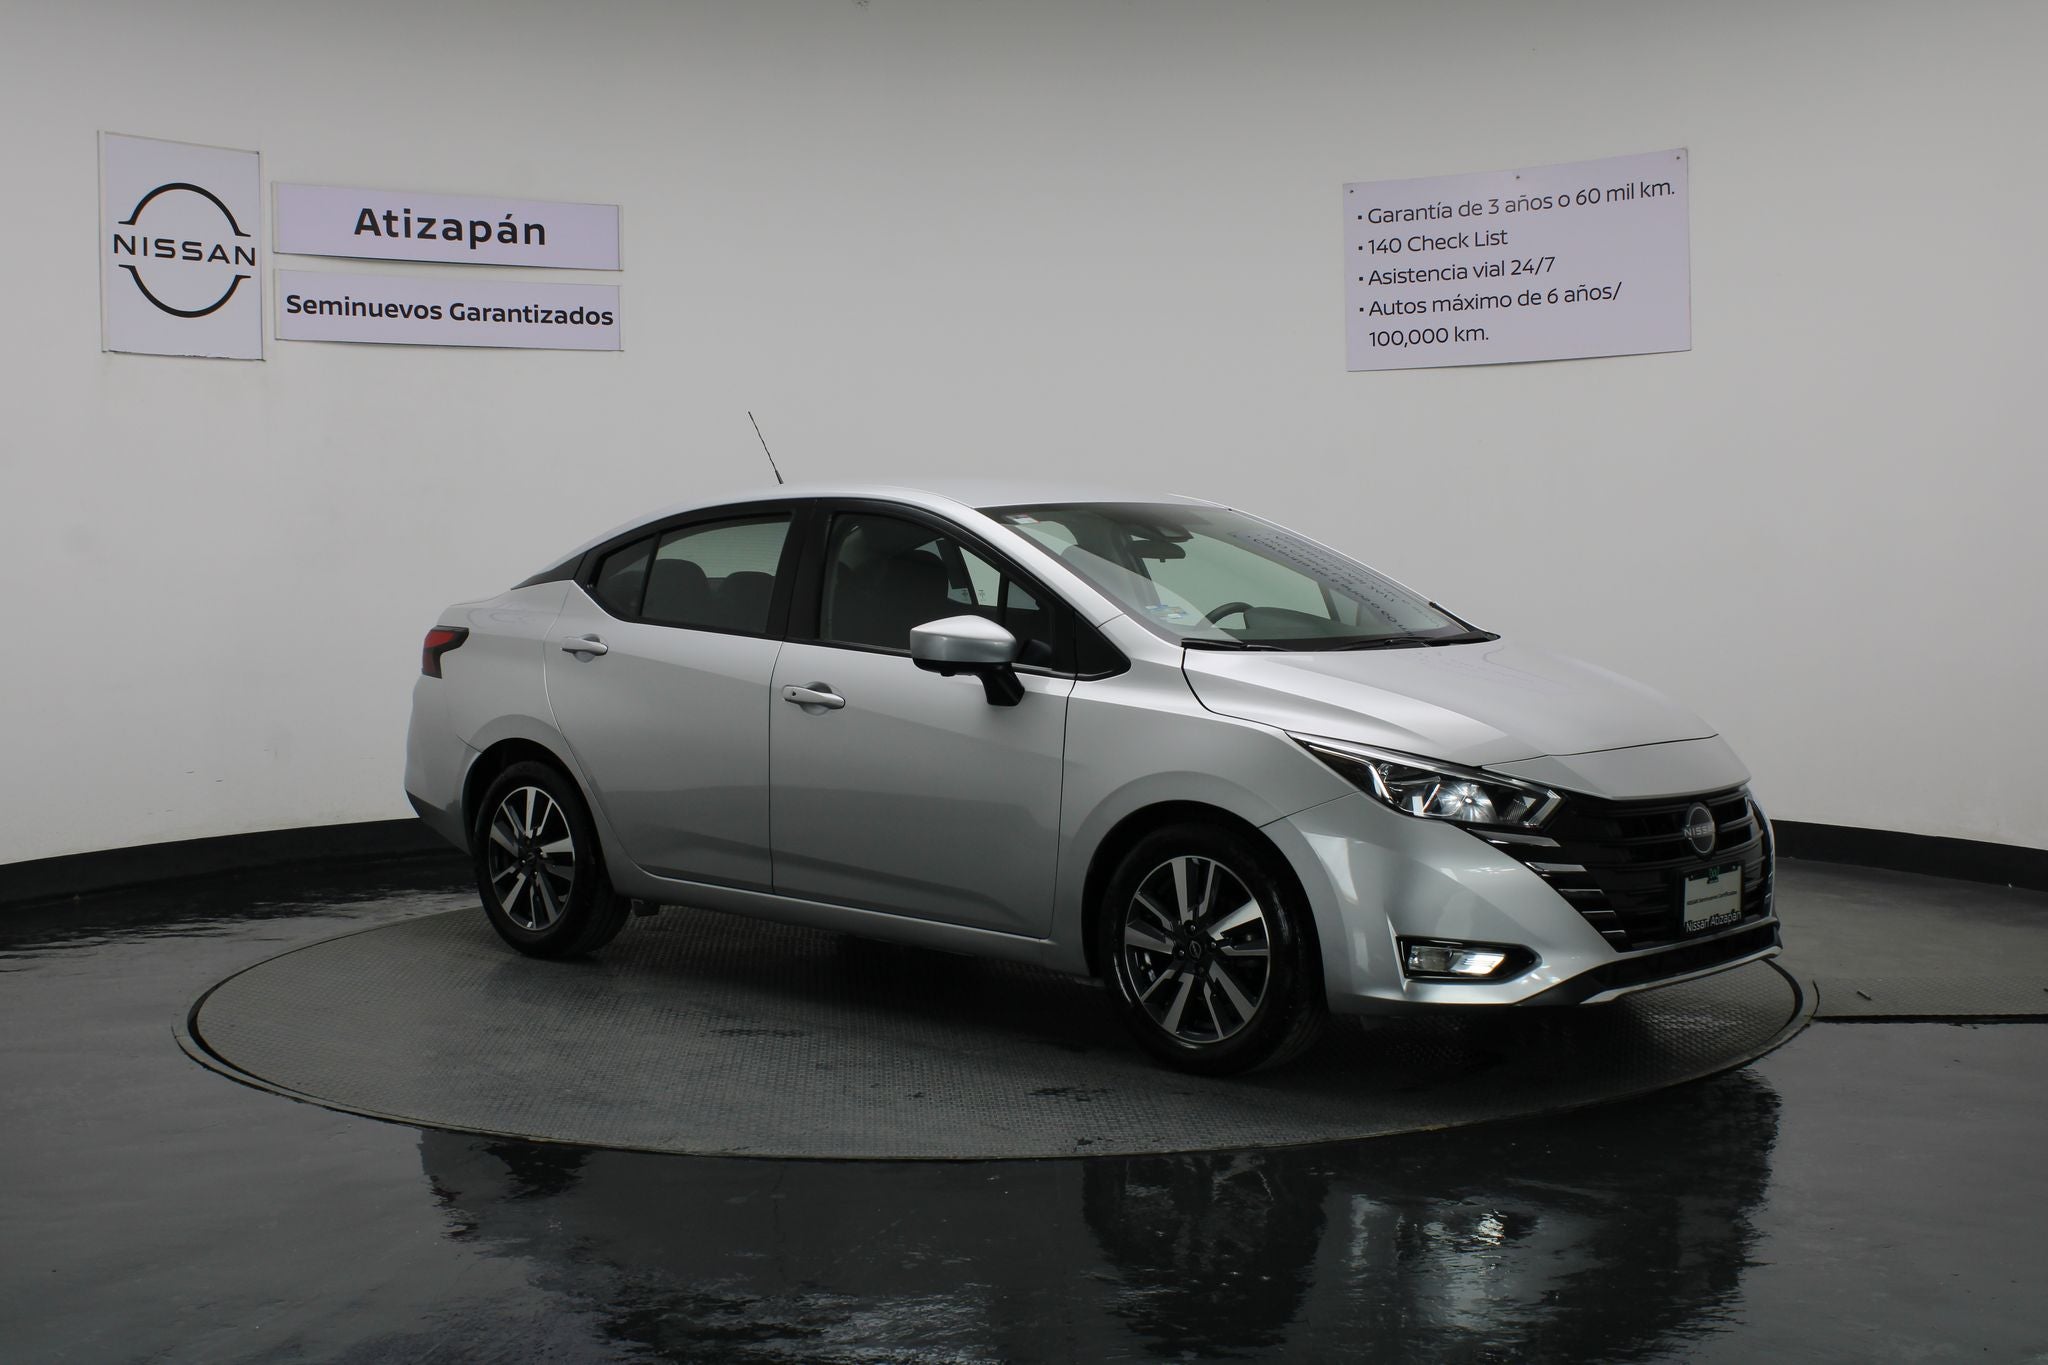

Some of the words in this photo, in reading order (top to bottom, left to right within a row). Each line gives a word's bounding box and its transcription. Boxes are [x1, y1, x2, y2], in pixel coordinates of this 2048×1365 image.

[1367, 201, 1453, 225] Garantía
[1458, 200, 1483, 218] de
[1488, 198, 1500, 215] 3
[1504, 194, 1553, 214] años
[1557, 194, 1571, 208] o
[1575, 187, 1601, 206] 60
[1606, 182, 1635, 203] mil
[1640, 181, 1676, 199] km.
[353, 207, 546, 250] Atizapán
[1367, 237, 1402, 255] 140
[1407, 232, 1469, 252] Check
[1474, 229, 1509, 248] List
[113, 233, 256, 267] NISSAN
[1367, 263, 1468, 286] Asistencia
[1472, 259, 1505, 279] vial
[1510, 256, 1556, 277] 24/7
[286, 294, 443, 321] Seminuevos
[449, 302, 614, 327] Garantizados
[1368, 298, 1427, 317] Autos
[1432, 293, 1513, 313] máximo
[1517, 289, 1542, 307] de
[1546, 287, 1559, 305] 6
[1564, 281, 1623, 303] años/
[1368, 327, 1449, 349] 100,000
[1454, 325, 1489, 343] km.
[1686, 919, 1710, 933] Nissan
